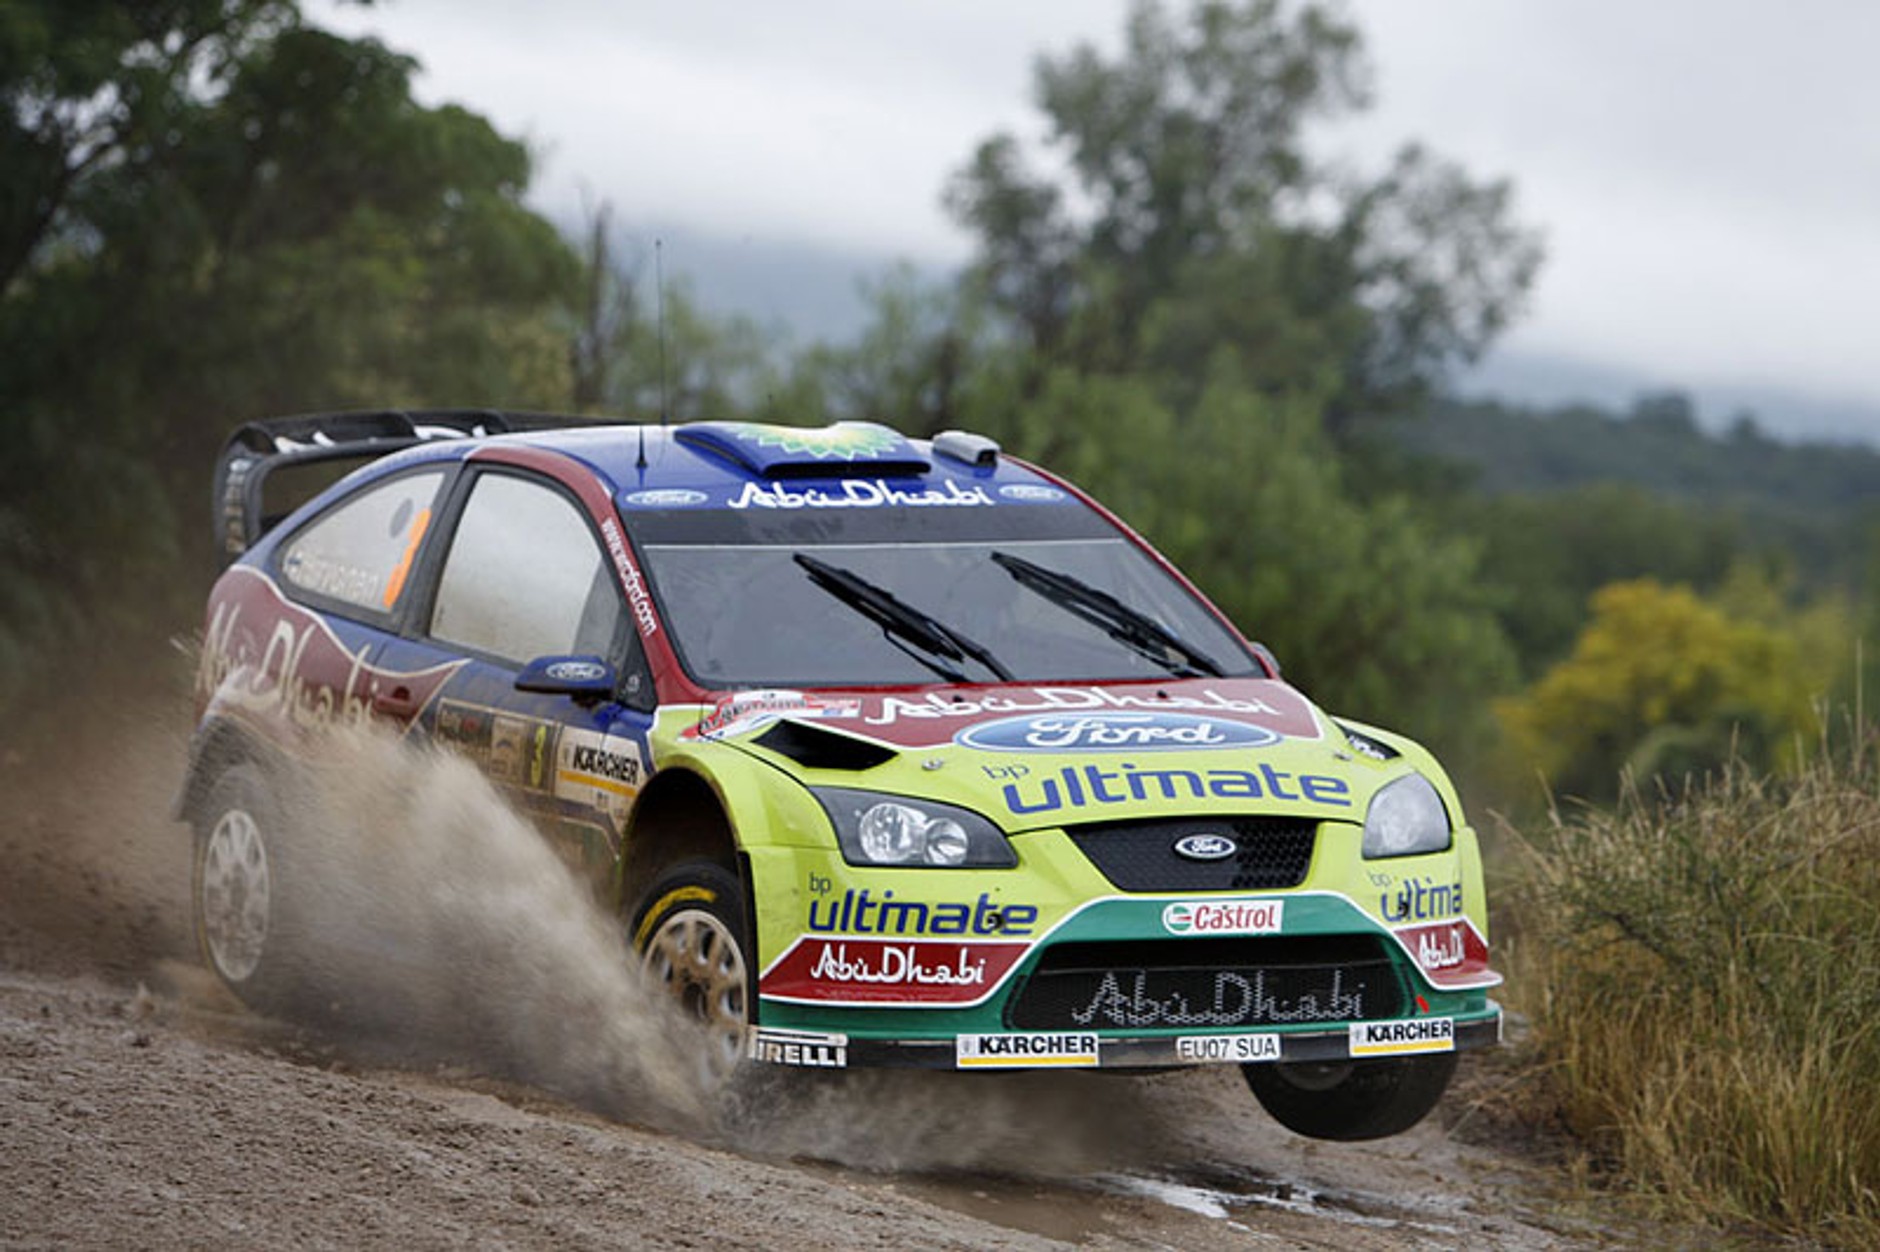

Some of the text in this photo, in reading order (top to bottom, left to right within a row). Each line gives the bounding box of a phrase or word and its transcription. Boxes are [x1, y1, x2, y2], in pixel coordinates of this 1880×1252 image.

[1026, 713, 1226, 747] Ford
[982, 762, 1029, 781] bp
[1003, 763, 1352, 815] ultimate
[809, 873, 832, 894] bp
[809, 889, 1039, 935] ultimate
[1194, 905, 1275, 931] Castrol
[979, 1035, 1096, 1055] KÄRCHER
[1181, 1037, 1278, 1059] EU07 SUA
